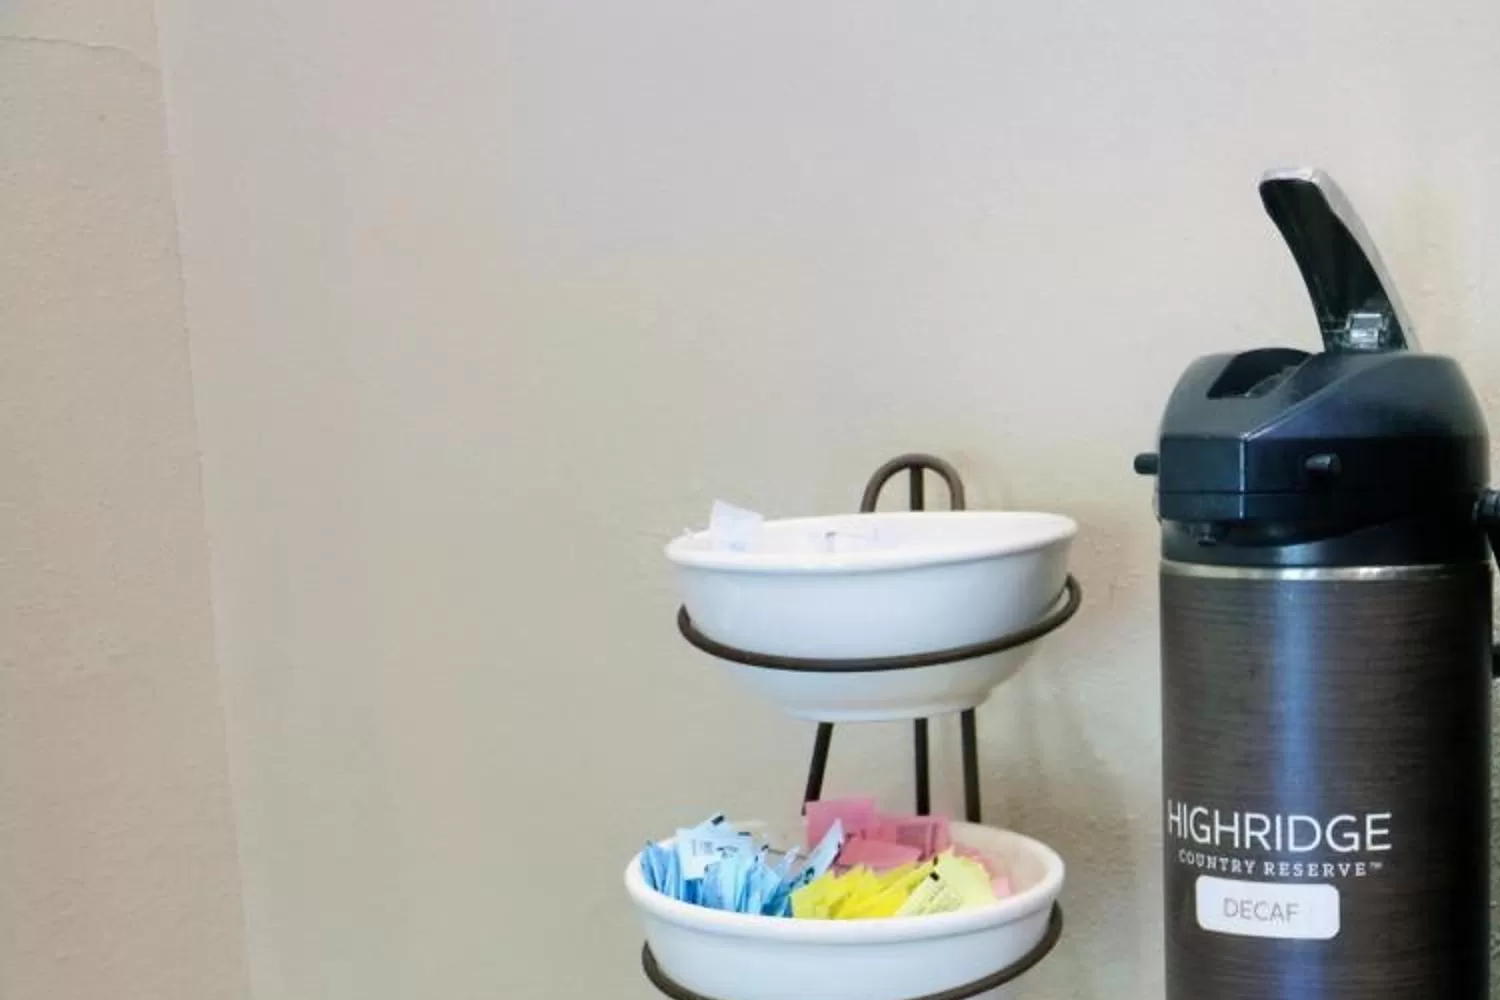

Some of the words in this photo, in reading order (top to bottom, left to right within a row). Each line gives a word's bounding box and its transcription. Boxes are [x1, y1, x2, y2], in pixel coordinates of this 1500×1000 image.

[1168, 800, 1393, 853] HIGHRIDGE
[1178, 848, 1256, 875] COUNTRY
[1264, 862, 1368, 878] RESERVE
[1223, 898, 1298, 923] DECAF
